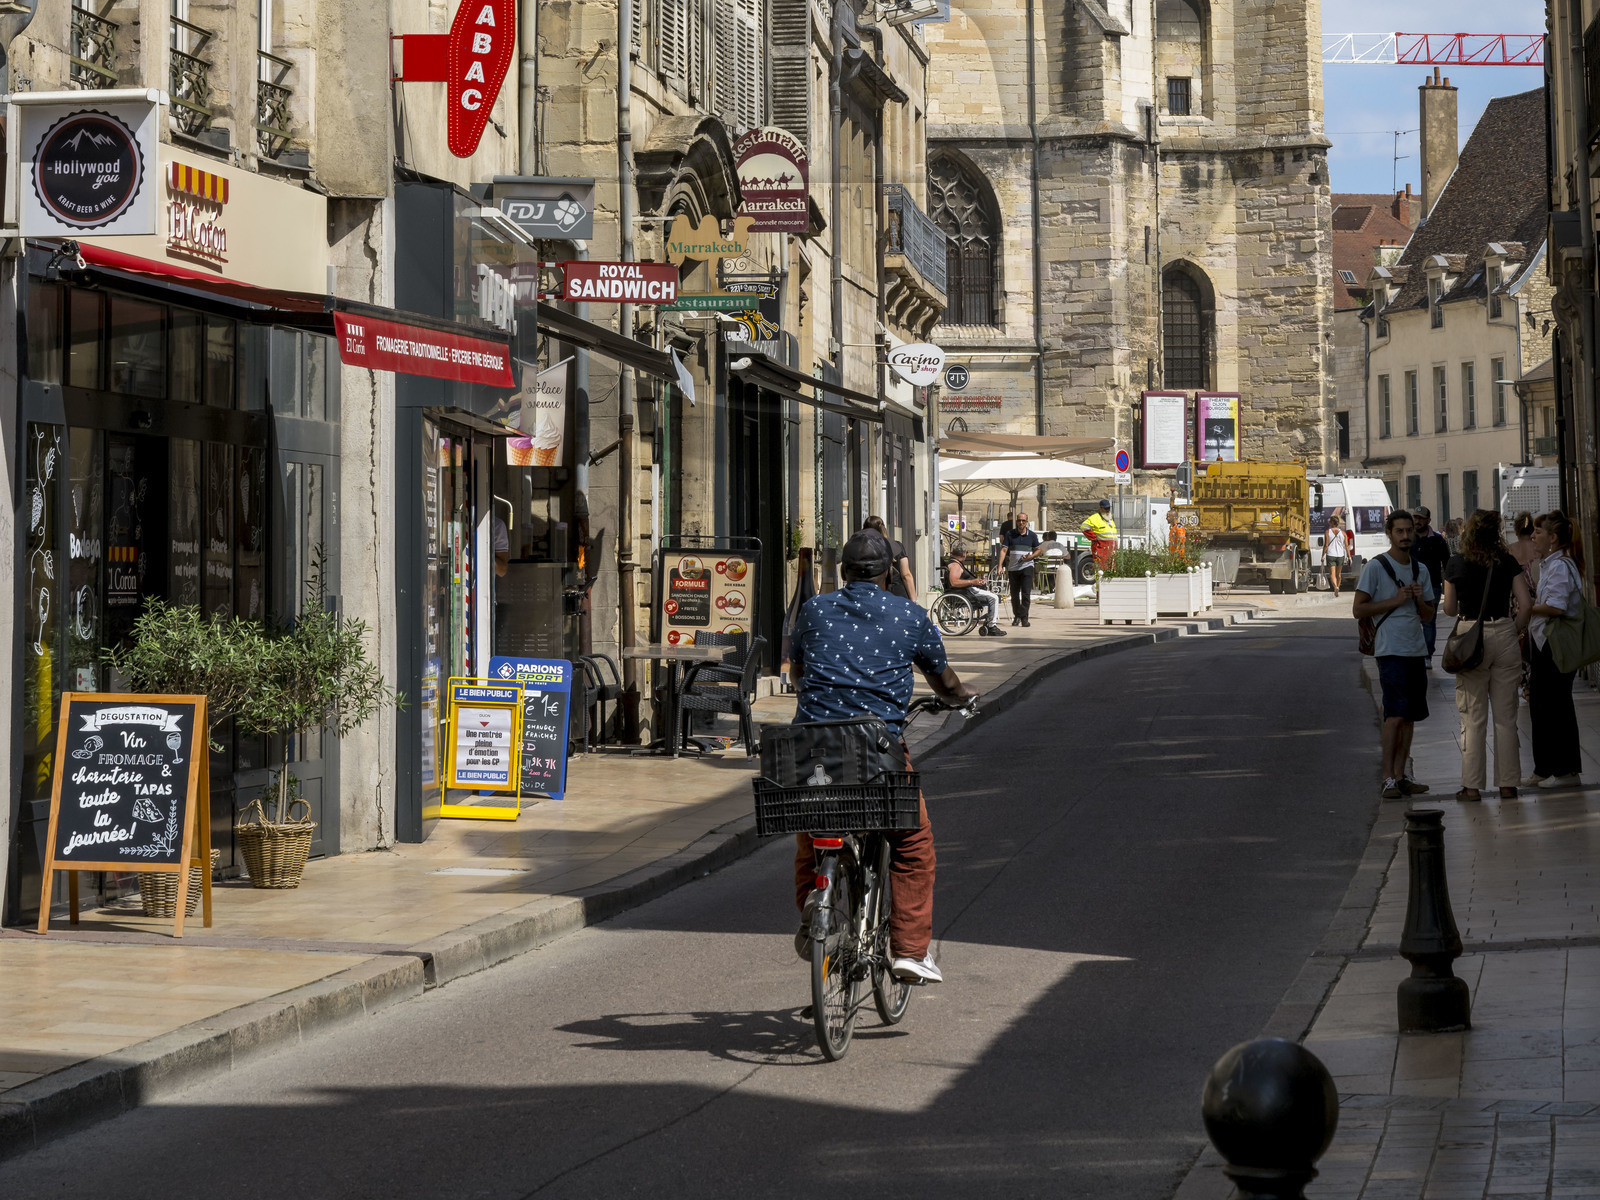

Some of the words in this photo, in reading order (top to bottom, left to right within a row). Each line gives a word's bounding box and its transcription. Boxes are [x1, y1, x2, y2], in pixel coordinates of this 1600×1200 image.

[92, 174, 120, 190] you
[57, 194, 76, 210] KRAFT
[76, 205, 93, 214] BEER
[99, 194, 117, 210] WINE
[507, 203, 546, 220] FDJ
[169, 201, 187, 241] El
[186, 205, 227, 252] Corón
[670, 241, 742, 254] Marrakech
[599, 265, 644, 279] ROYAL
[569, 278, 675, 300] SANDWICH
[346, 337, 353, 353] El
[353, 338, 366, 355] Corón
[376, 335, 409, 356] FROMAGERIE
[409, 341, 449, 362] TRADITIONNELLE
[472, 351, 483, 367] FINE
[482, 351, 504, 371] IBÉRIQUE
[892, 353, 940, 366] Casino
[920, 364, 938, 374] shop
[69, 531, 101, 564] Bodega
[114, 567, 137, 590] Corón
[675, 580, 706, 588] FORMULE
[667, 602, 677, 611] 9€
[516, 663, 564, 675] PARIONS
[518, 673, 561, 682] SPORT
[459, 688, 468, 696] LE
[469, 689, 486, 697] BIEN
[486, 689, 513, 698] PUBLIC
[100, 713, 163, 721] DEGUSTATION
[120, 731, 147, 748] Vin
[466, 730, 477, 738] Une
[478, 731, 502, 739] rentrée
[474, 740, 492, 748] pleine
[98, 753, 164, 766] FROMAGE
[466, 758, 480, 766] pour
[491, 758, 500, 766] CP
[71, 766, 144, 785] charcuterie
[161, 764, 173, 778] &
[458, 770, 467, 778] LE
[467, 771, 483, 779] BIEN
[483, 771, 507, 780] PUBLIC
[134, 783, 173, 796] TAPAS
[79, 787, 121, 809] toute
[93, 809, 112, 827] la
[63, 822, 137, 856] journée!
